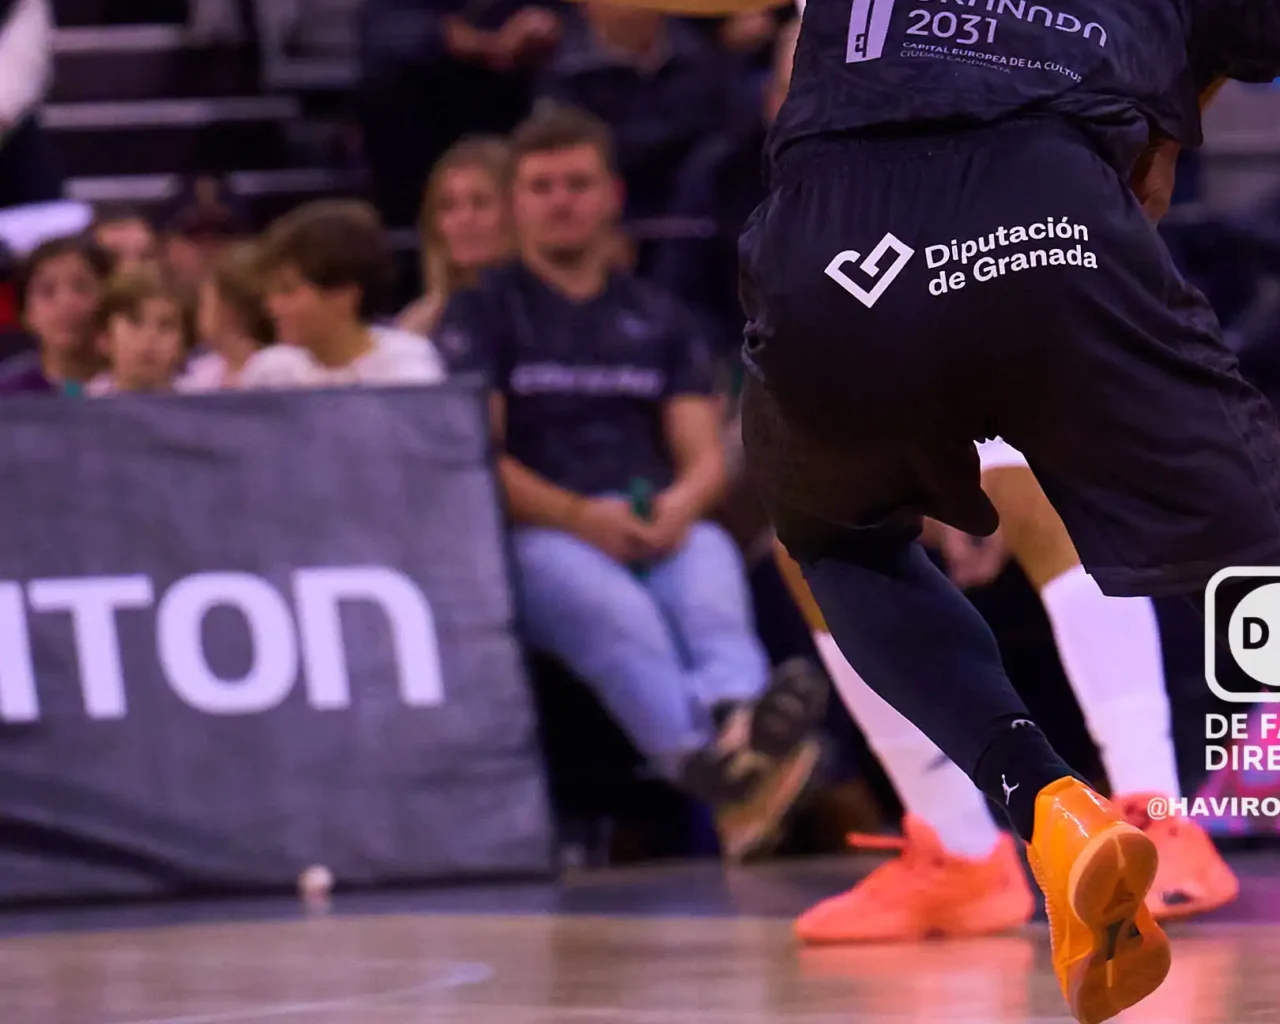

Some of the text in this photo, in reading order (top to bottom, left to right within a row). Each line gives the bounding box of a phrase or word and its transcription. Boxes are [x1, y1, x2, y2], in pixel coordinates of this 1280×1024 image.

[905, 8, 998, 45] 2031
[902, 41, 950, 55] CAPITAL
[951, 48, 1007, 65] EUROPEA
[1009, 57, 1024, 68] DE
[1027, 60, 1042, 70] LA
[924, 216, 1089, 265] Diputación
[928, 244, 1098, 297] de Granada
